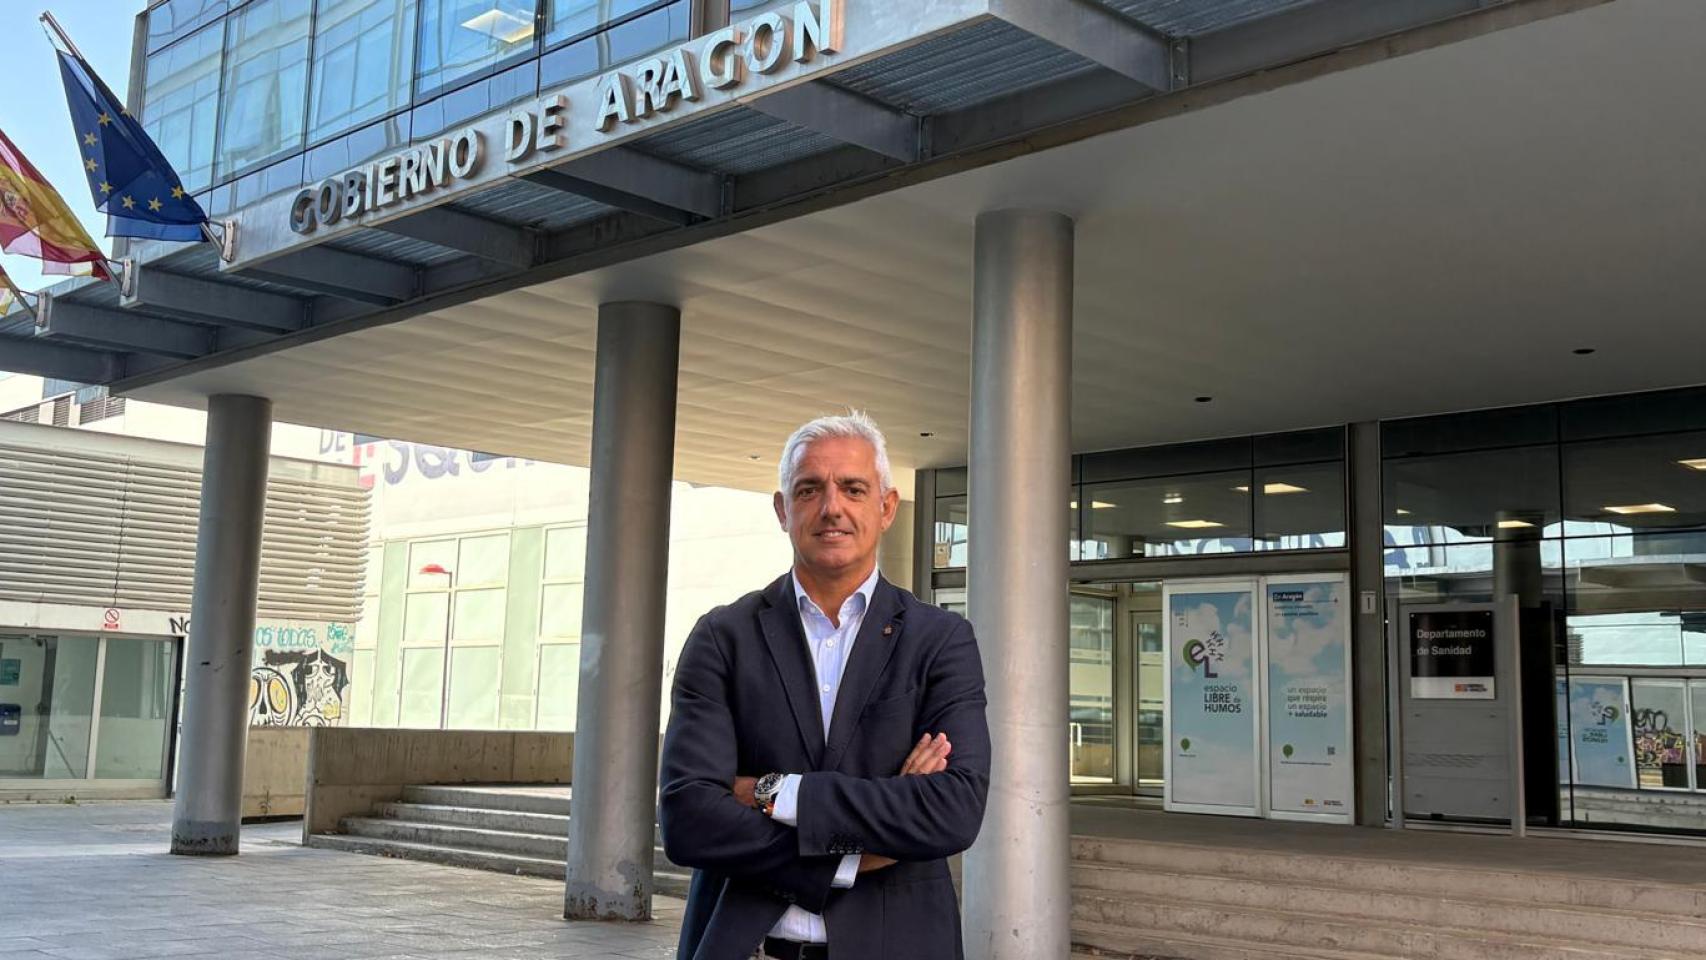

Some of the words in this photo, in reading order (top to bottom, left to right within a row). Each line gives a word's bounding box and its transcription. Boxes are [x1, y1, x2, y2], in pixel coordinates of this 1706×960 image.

[290, 127, 484, 235] GOBIERNO
[504, 94, 568, 163] DE
[1416, 628, 1486, 640] Departamento
[1416, 647, 1429, 656] de
[1431, 645, 1472, 656] Sanidad
[1204, 684, 1238, 694] espacio
[1203, 693, 1231, 704] LIBRE
[1203, 703, 1242, 714] HUMOS
